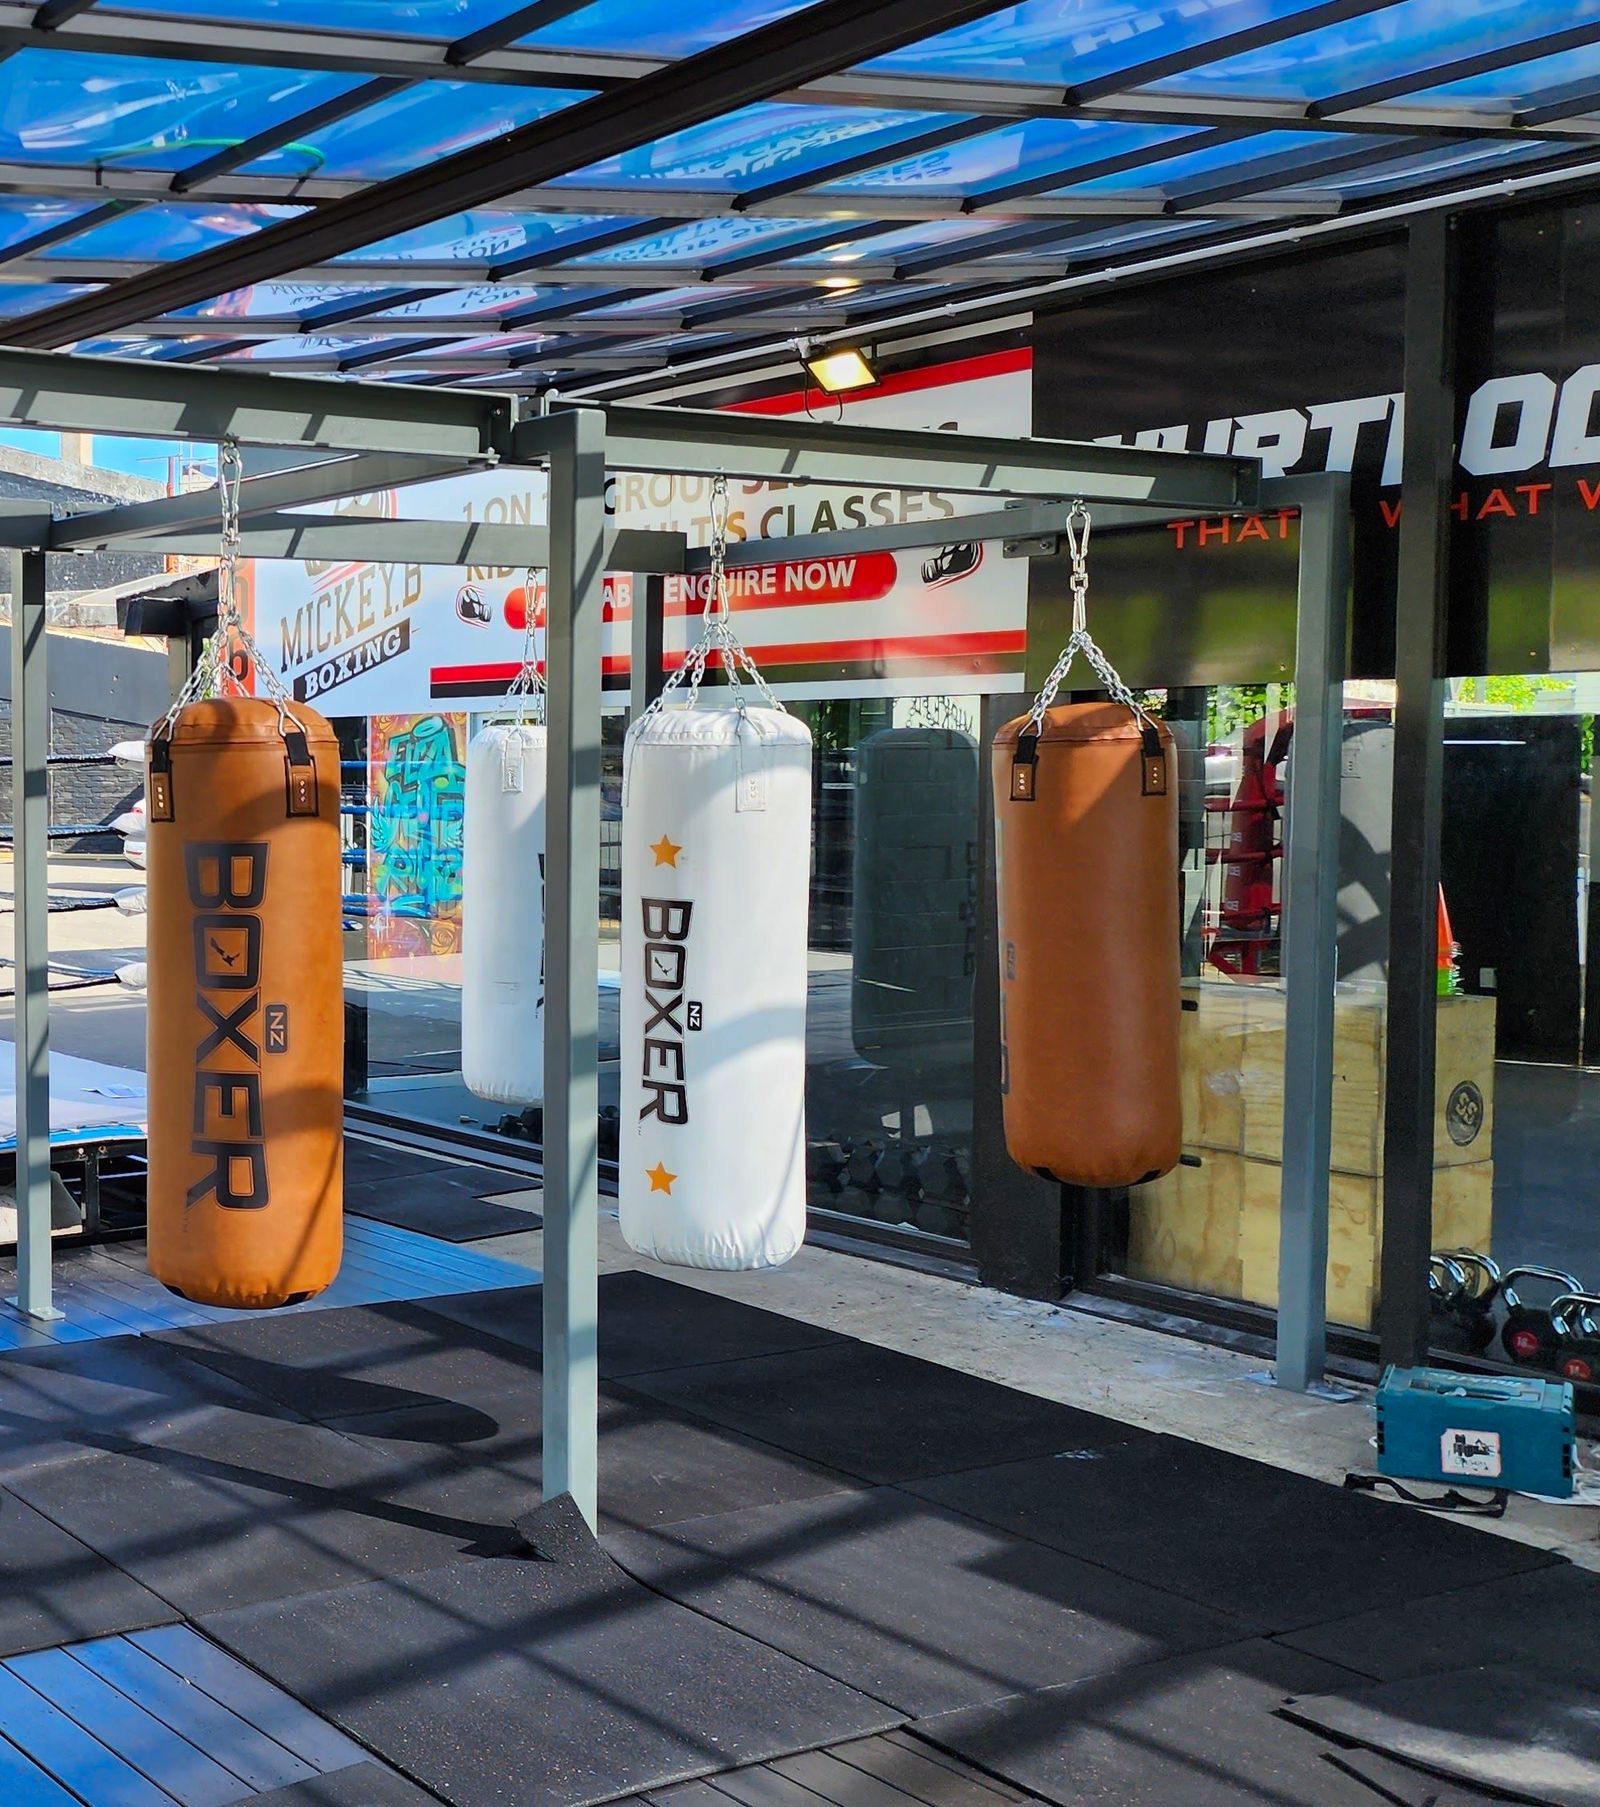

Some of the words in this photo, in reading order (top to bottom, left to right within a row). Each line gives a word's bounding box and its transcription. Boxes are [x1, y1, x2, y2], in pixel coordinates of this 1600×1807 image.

[603, 474, 714, 516] GROU
[1167, 507, 1300, 550] THAT
[784, 558, 857, 593] NOW
[304, 627, 402, 700] BOXING
[184, 841, 271, 1211] BOXER
[267, 1006, 287, 1052] NZ
[639, 898, 694, 1126] BOXER
[688, 1002, 702, 1030] NZ
